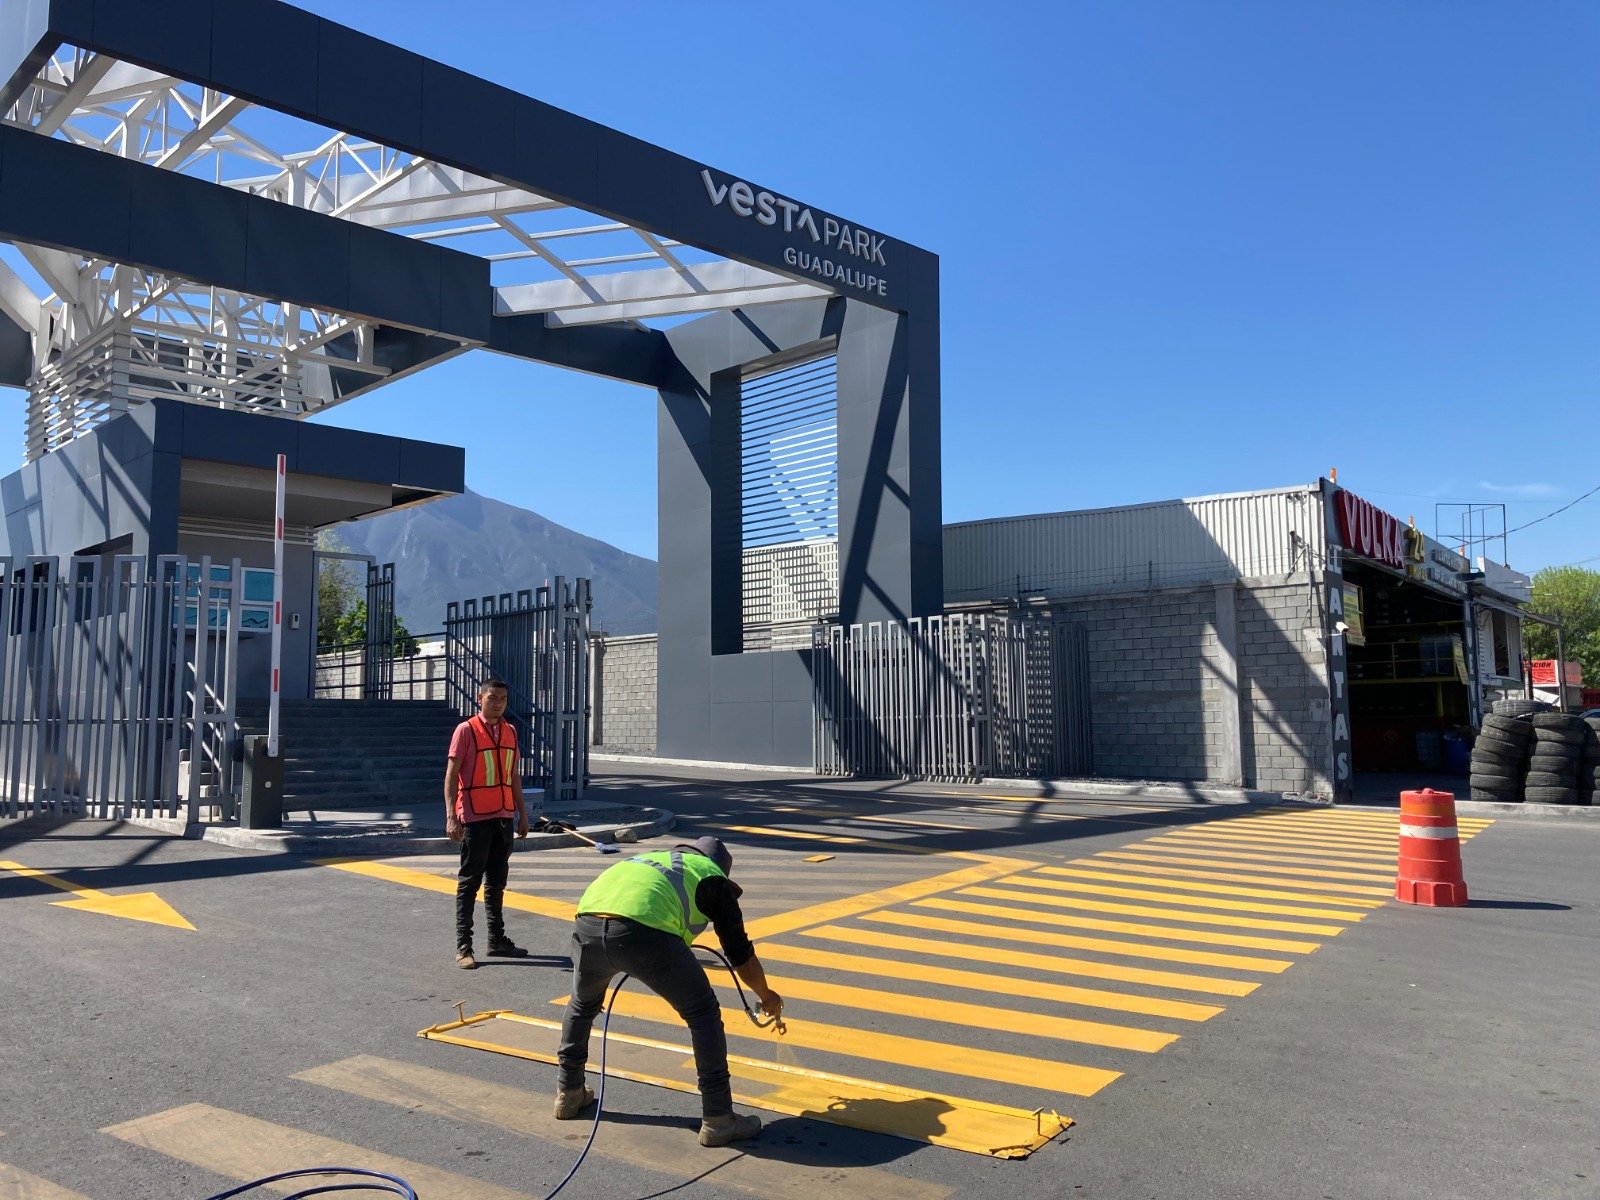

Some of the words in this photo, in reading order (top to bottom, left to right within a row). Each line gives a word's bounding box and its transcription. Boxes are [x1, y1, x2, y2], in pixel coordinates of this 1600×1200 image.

[823, 217, 886, 267] PARK
[783, 247, 887, 296] GUADALUPE
[1343, 489, 1405, 569] VULKA
